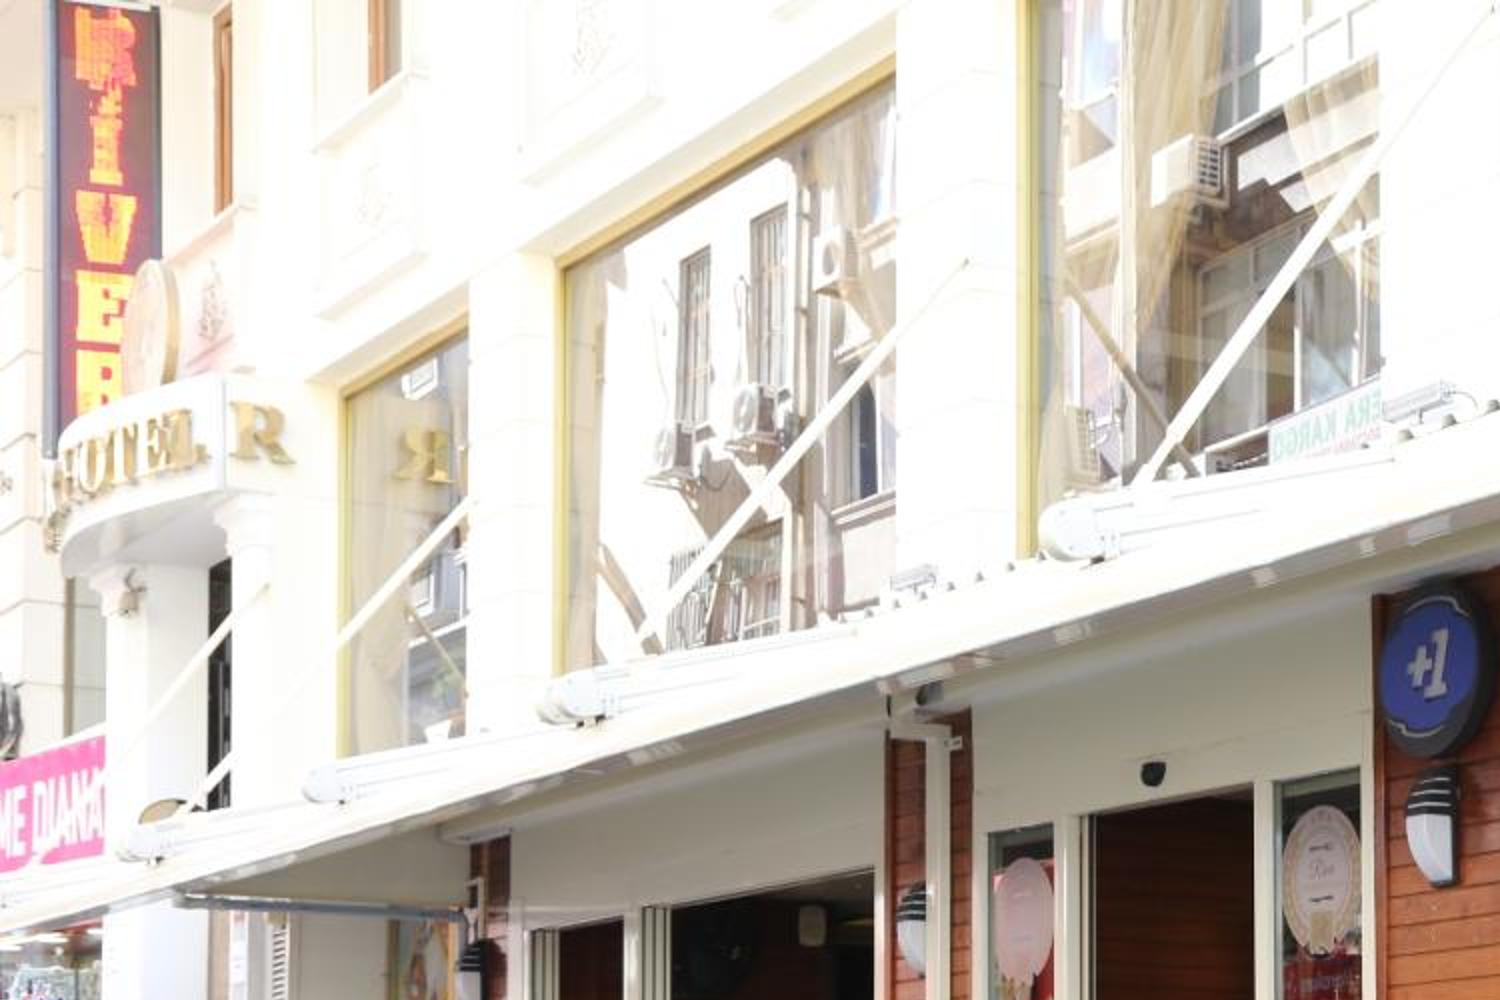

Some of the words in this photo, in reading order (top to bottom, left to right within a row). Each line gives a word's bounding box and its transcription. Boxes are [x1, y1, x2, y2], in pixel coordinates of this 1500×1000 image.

[75, 8, 137, 416] RIVER
[228, 401, 297, 465] R
[1406, 627, 1450, 701] +1
